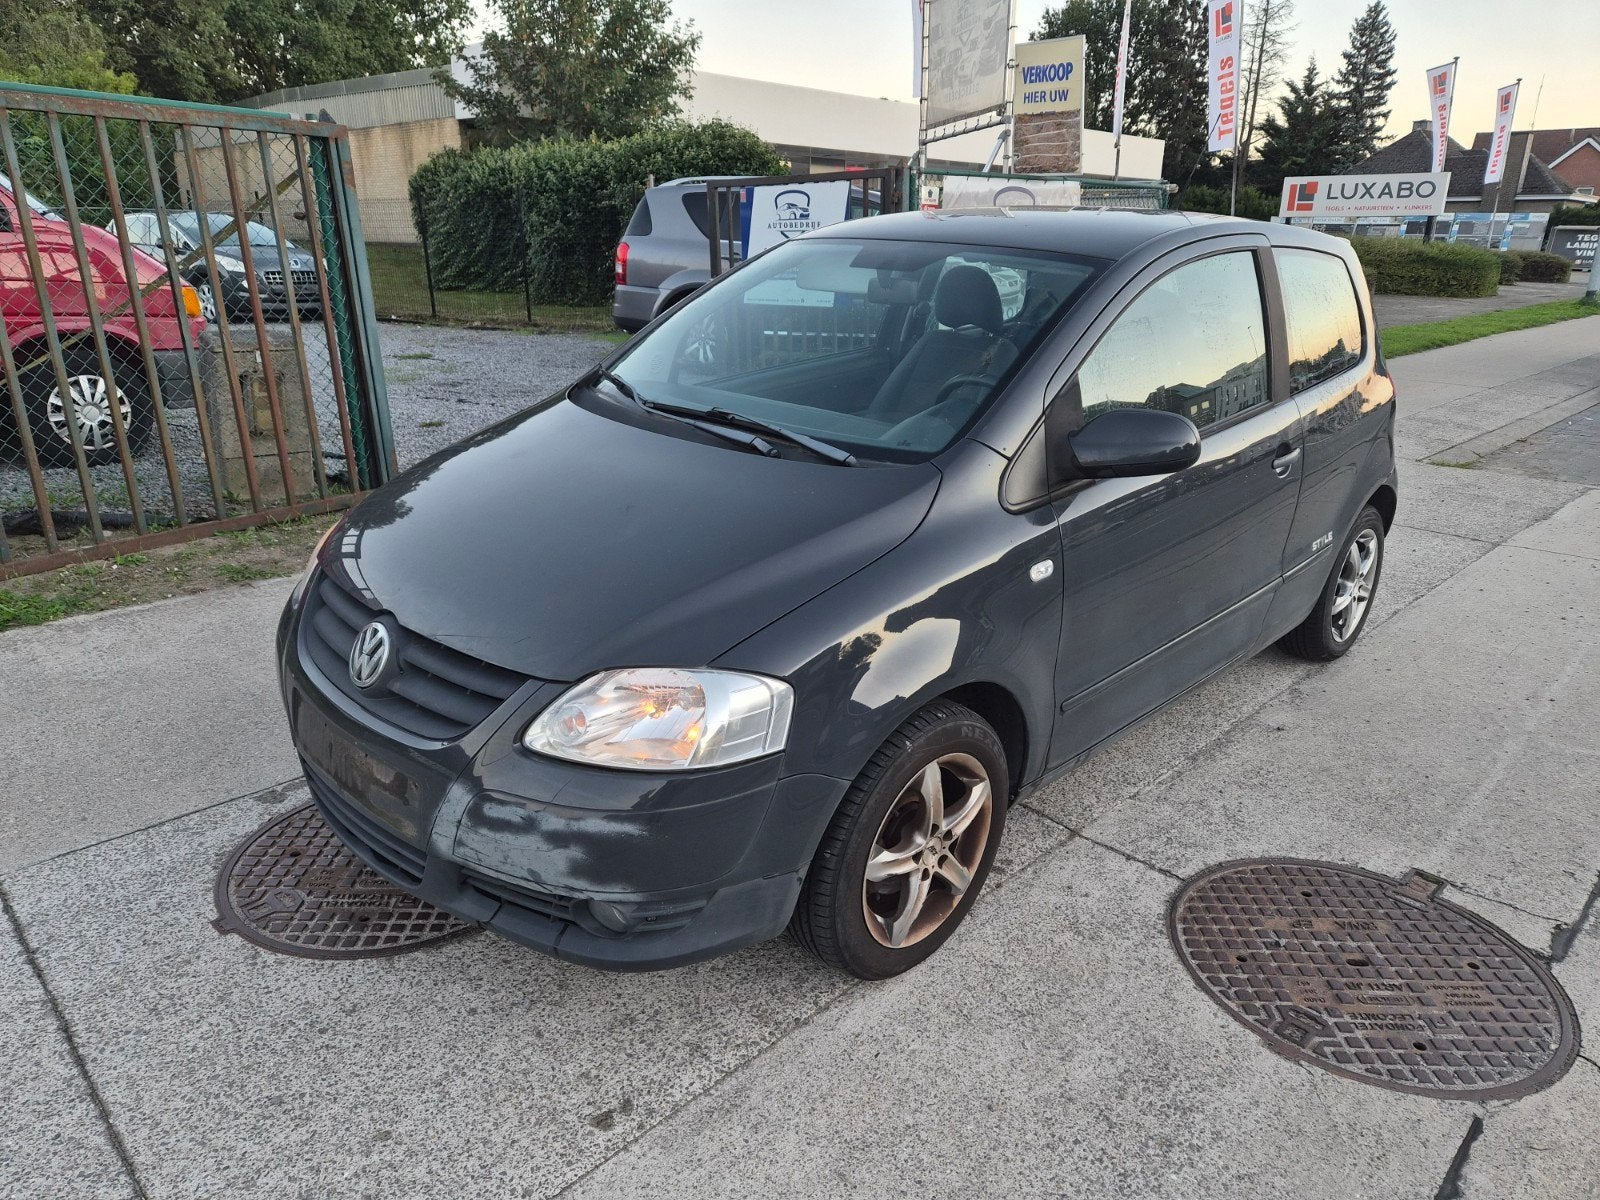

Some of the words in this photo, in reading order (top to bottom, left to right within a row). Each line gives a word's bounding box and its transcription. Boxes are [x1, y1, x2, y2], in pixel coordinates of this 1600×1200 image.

[1022, 62, 1074, 84] VERKOOP
[1023, 90, 1047, 104] HIER
[1050, 89, 1070, 102] UW
[1217, 55, 1235, 141] Tegels
[1326, 180, 1437, 200] LUXABO
[767, 221, 821, 230] AUTOBEDRIJF
[348, 622, 390, 688] VW
[1350, 1012, 1415, 1022] LECOMTE
[1350, 1022, 1425, 1032] FONDATEL
